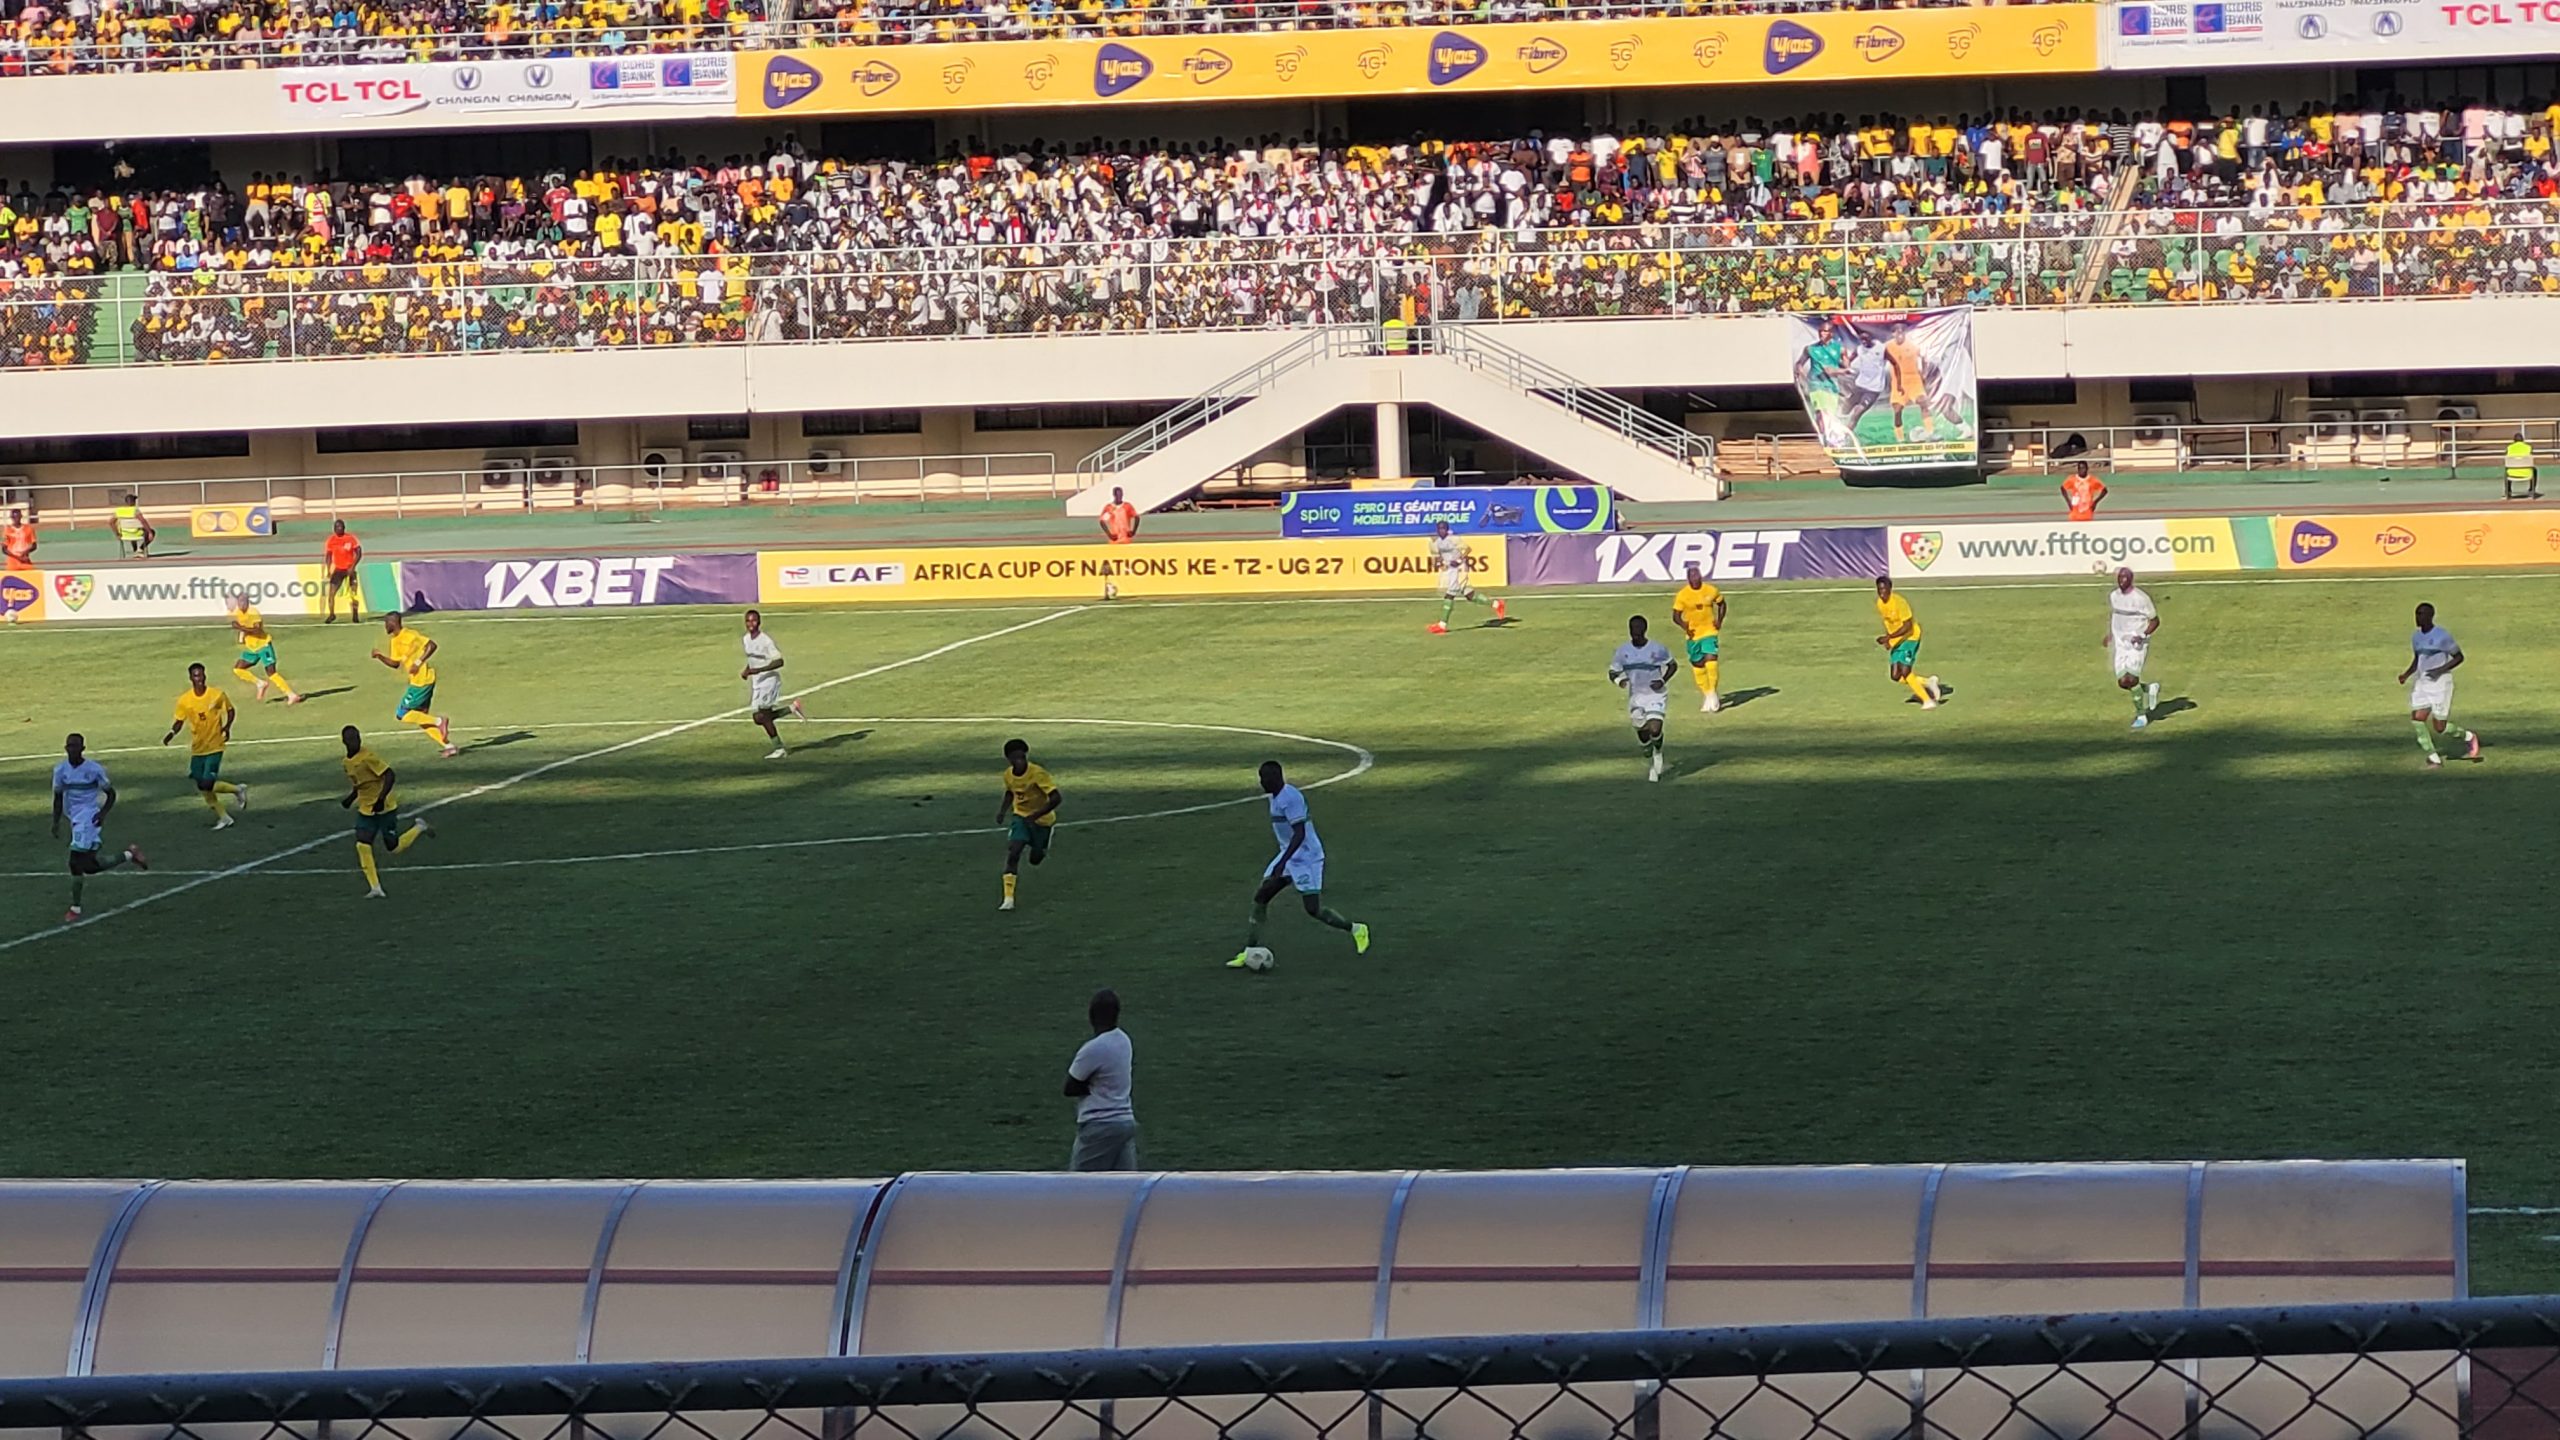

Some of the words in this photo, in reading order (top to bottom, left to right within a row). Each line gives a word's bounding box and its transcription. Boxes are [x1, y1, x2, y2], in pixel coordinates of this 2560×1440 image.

[2153, 17, 2187, 28] BANK
[2441, 4, 2511, 26] TCL
[943, 70, 965, 84] 5G
[1276, 58, 1297, 73] 5G
[1610, 47, 1632, 61] 5G
[1948, 36, 1970, 50] 5G
[282, 83, 348, 103] TCL
[354, 79, 421, 100] TCL
[436, 95, 500, 105] CHANGAN
[507, 92, 572, 103] CHANGAN
[1300, 506, 1341, 524] spiro
[1353, 503, 1386, 513] SPIRO
[1388, 502, 1401, 512] LE
[1403, 500, 1442, 512] GÉANT
[1443, 501, 1459, 511] DE
[1461, 500, 1476, 511] LA
[1404, 514, 1421, 524] EN
[1422, 513, 1470, 524] AFRIQUE
[1958, 531, 2215, 562] www.ftftogo.com
[2375, 533, 2411, 545] Fibre
[2464, 534, 2482, 546] 5G
[1595, 530, 1801, 582] 1XBET
[828, 567, 893, 582] CAF
[914, 562, 994, 581] AFRICA
[999, 560, 1041, 579] CUP
[1046, 559, 1075, 578] OF
[1187, 558, 1216, 576] KE
[1234, 558, 1261, 575] TZ
[1278, 558, 1311, 575] UG
[1316, 557, 1344, 574] 27
[484, 557, 675, 608] 1XBET
